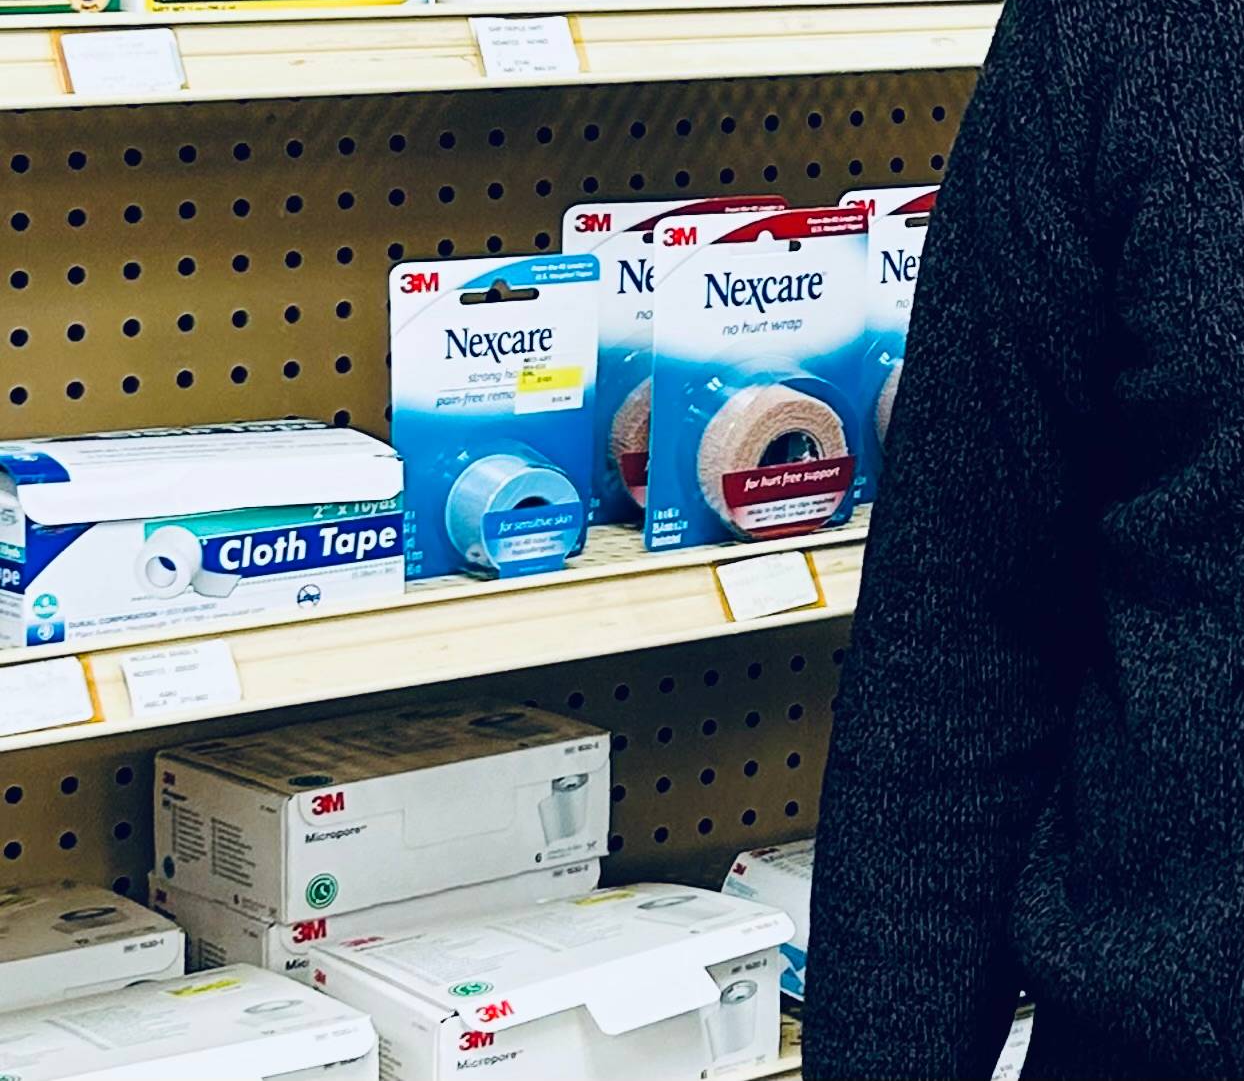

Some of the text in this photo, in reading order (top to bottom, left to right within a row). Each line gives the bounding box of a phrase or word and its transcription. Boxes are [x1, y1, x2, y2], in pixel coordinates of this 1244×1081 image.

[573, 213, 612, 234] 3M
[662, 227, 697, 248] 3M
[400, 272, 440, 294] 3M
[703, 270, 825, 314] Nexcare
[722, 318, 803, 336] no hurt wrap
[444, 326, 554, 364] Nexcare
[467, 369, 500, 385] strong
[435, 390, 490, 409] pain-free
[744, 466, 841, 492] for hurt free support
[218, 526, 398, 572] Cloth Tape
[311, 791, 345, 816] 3M
[304, 826, 361, 844] Micropore
[292, 918, 328, 945] 3M
[475, 999, 515, 1024] 3M
[458, 1029, 497, 1052] 3M
[456, 1050, 517, 1071] Micropore
